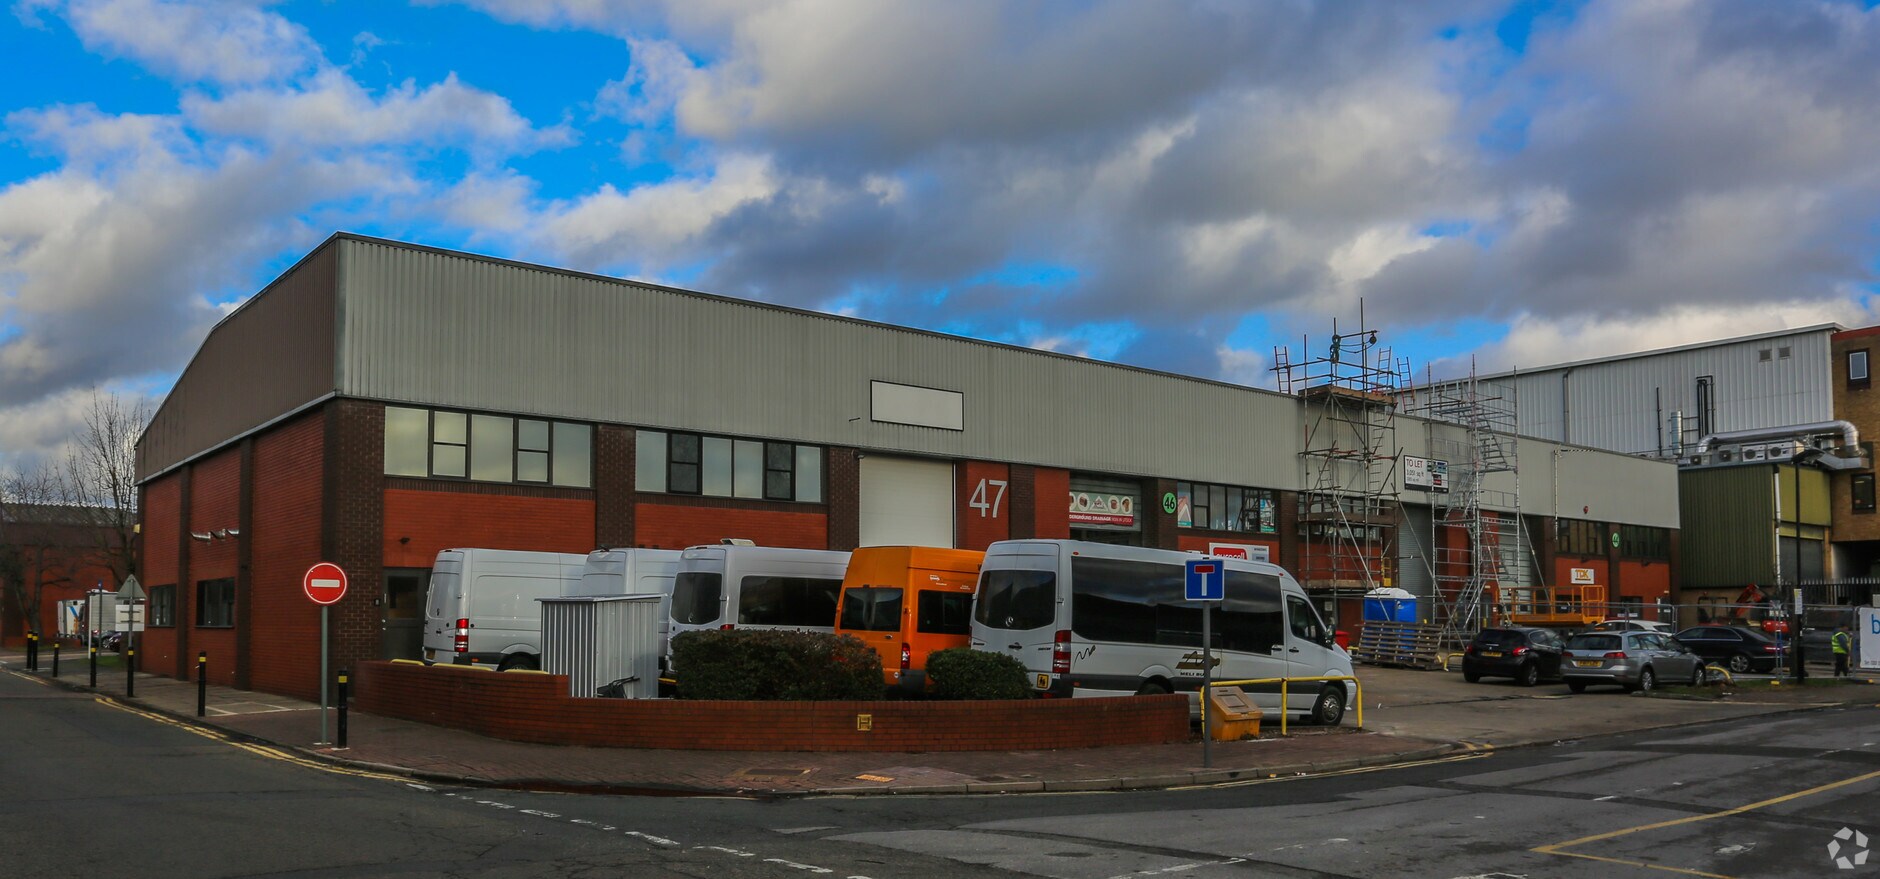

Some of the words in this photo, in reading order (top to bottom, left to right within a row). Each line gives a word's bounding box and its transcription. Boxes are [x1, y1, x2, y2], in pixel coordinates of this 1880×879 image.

[1406, 458, 1414, 467] TO
[1414, 460, 1423, 468] LET
[969, 478, 1008, 518] 47
[1164, 496, 1176, 510] 46
